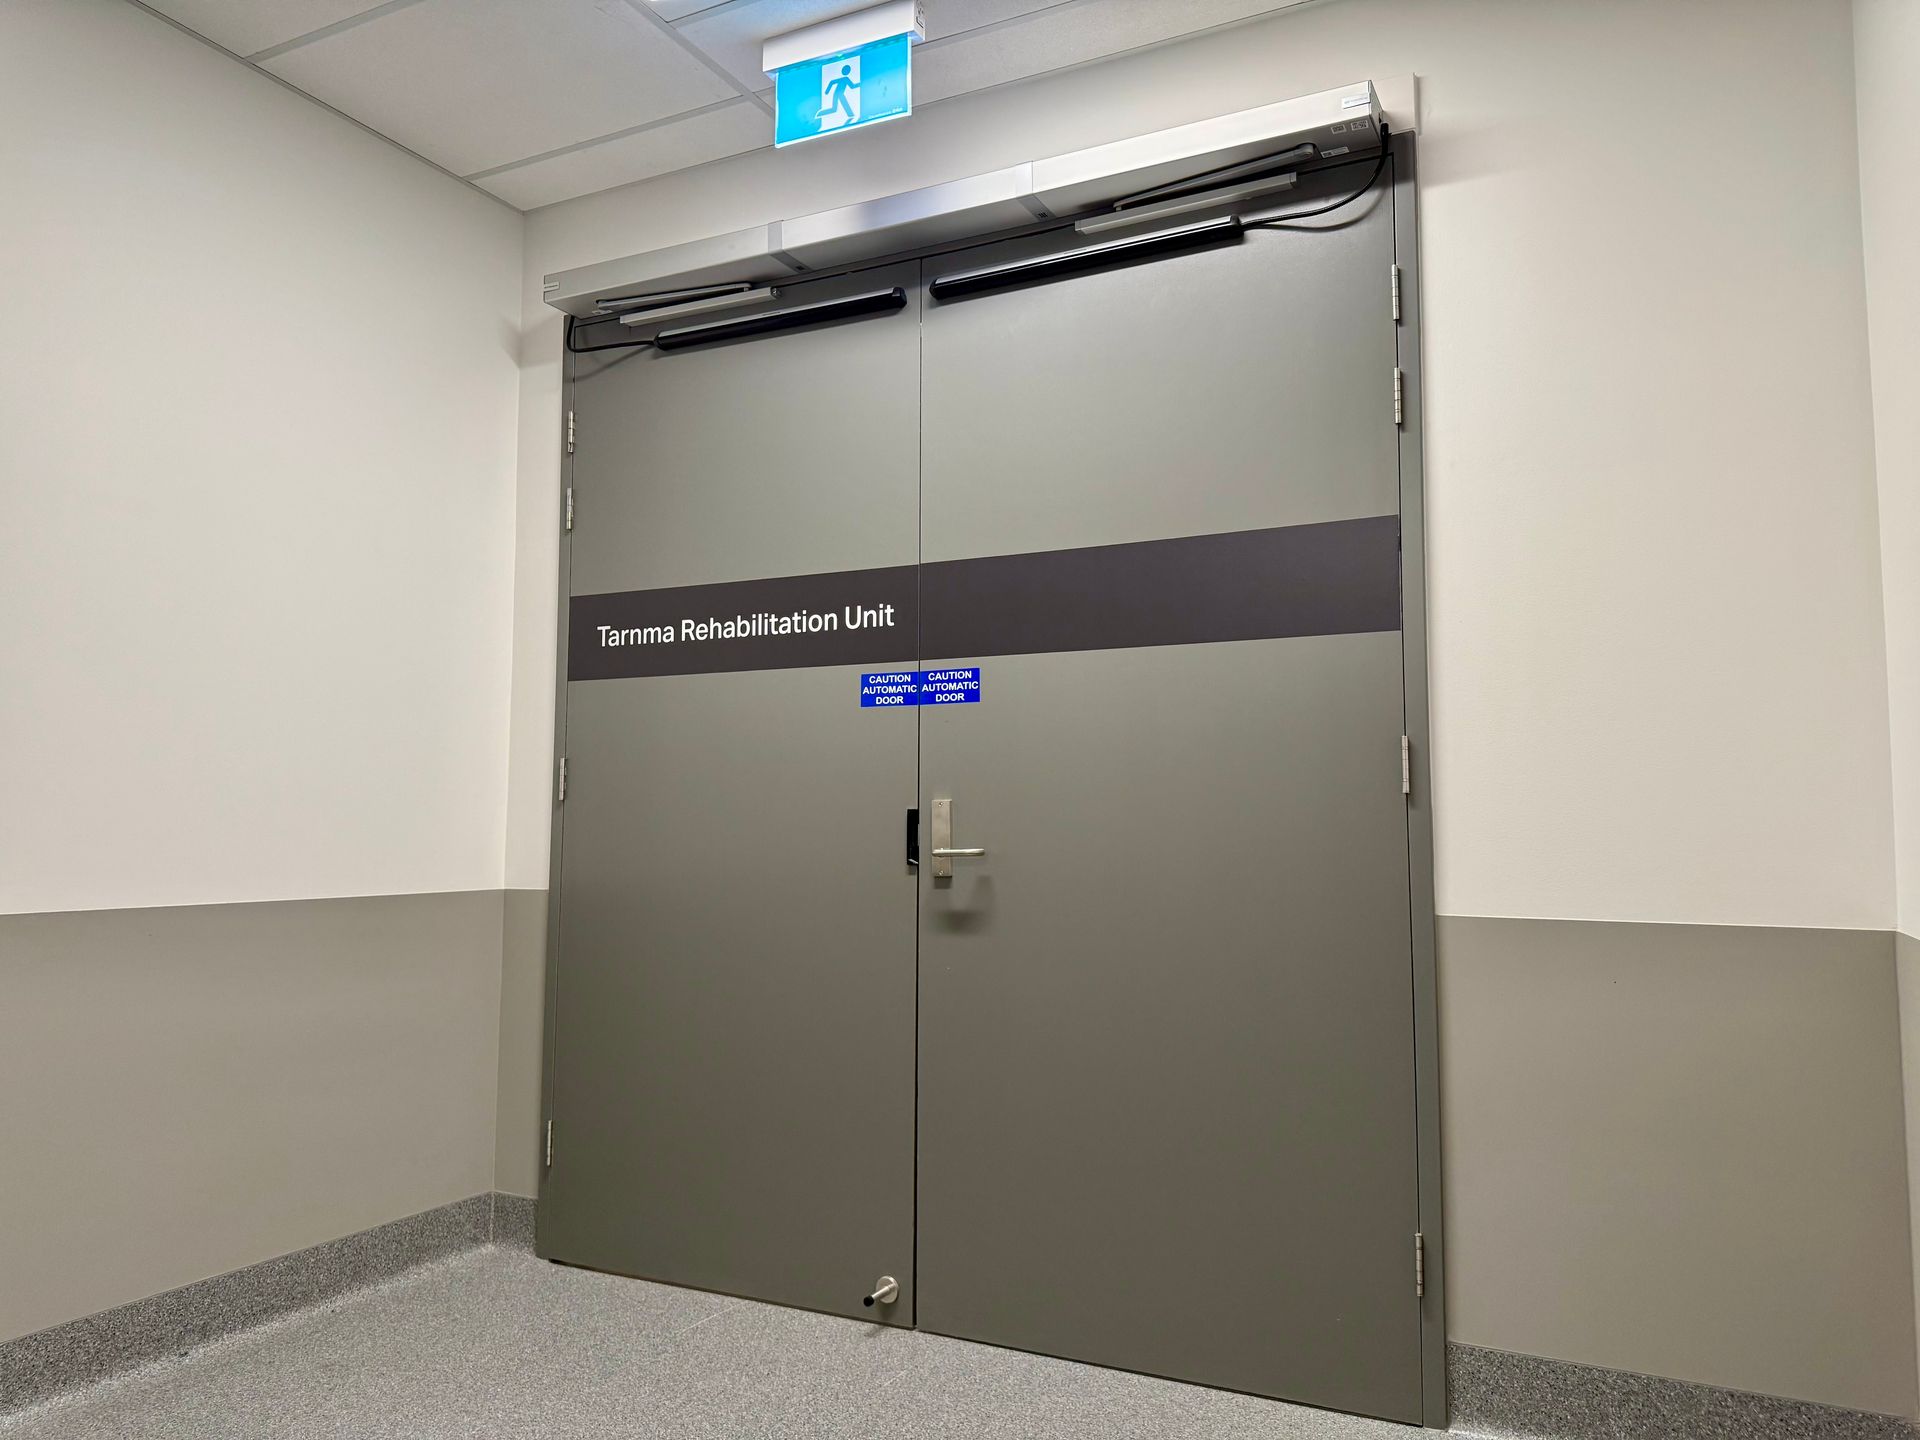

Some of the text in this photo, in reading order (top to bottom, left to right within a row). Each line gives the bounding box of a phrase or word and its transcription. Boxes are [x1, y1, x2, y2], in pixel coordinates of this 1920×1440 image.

[597, 603, 895, 647] Tarnma Rehabilitation Unit
[869, 674, 911, 684] CAUTION
[928, 671, 972, 681] CAUTION
[862, 685, 917, 695] AUTOMATIC
[922, 681, 979, 692] AUTOMATIC
[876, 696, 904, 705] DOOR
[936, 693, 965, 702] DOOR
